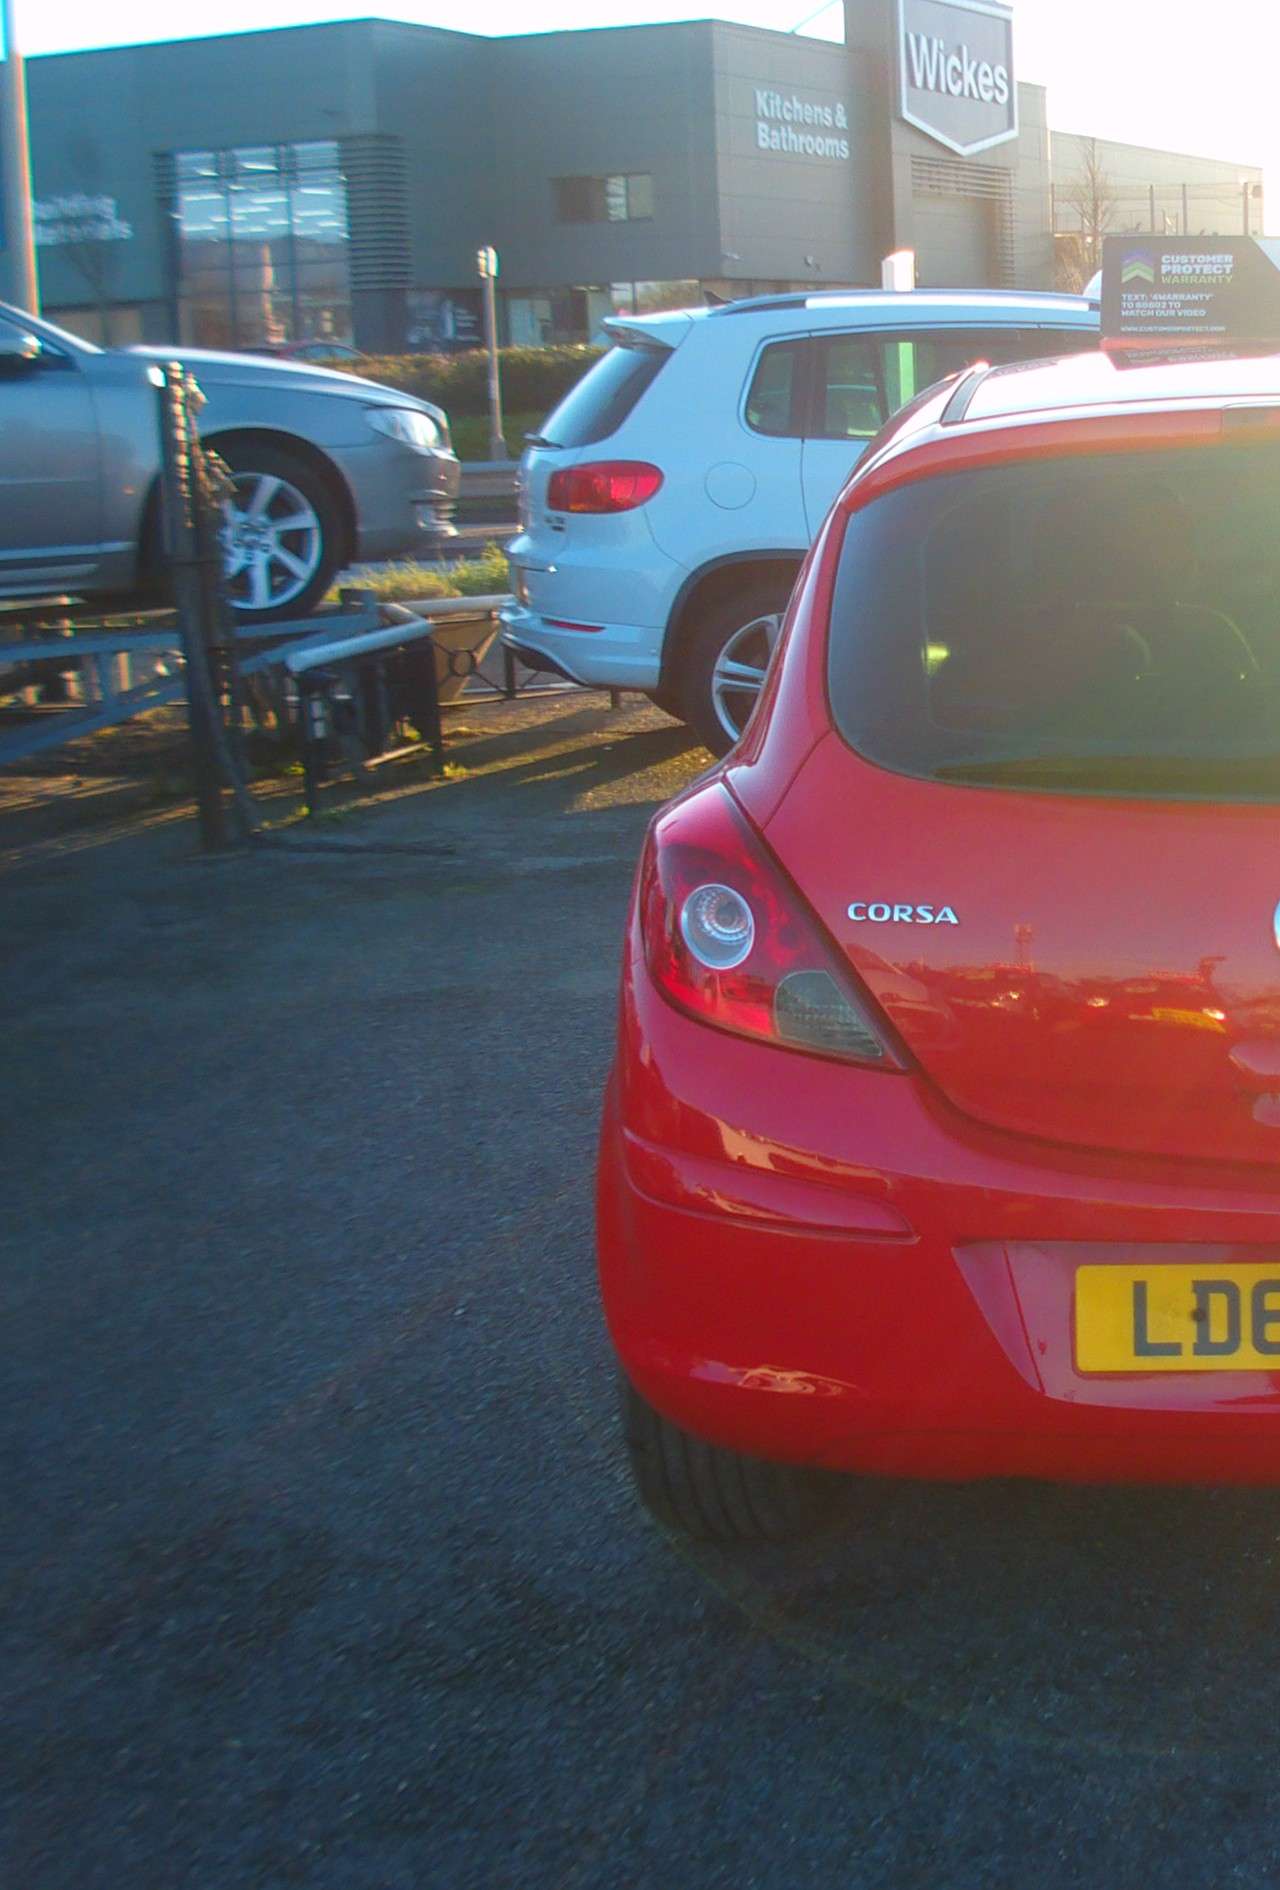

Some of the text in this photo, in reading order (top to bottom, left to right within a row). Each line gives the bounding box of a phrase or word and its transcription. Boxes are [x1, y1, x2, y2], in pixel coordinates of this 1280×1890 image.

[905, 31, 1010, 106] Wickes
[755, 89, 848, 130] Kitchens &
[756, 121, 849, 160] Bathrooms
[1161, 254, 1234, 263] CUSTOMER
[1161, 264, 1234, 274] PROTECT
[1161, 274, 1233, 284] WARRANTY
[1121, 301, 1134, 309] TO
[1168, 301, 1182, 309] TO
[1177, 308, 1207, 317] VIDEO
[847, 902, 959, 924] CORSA
